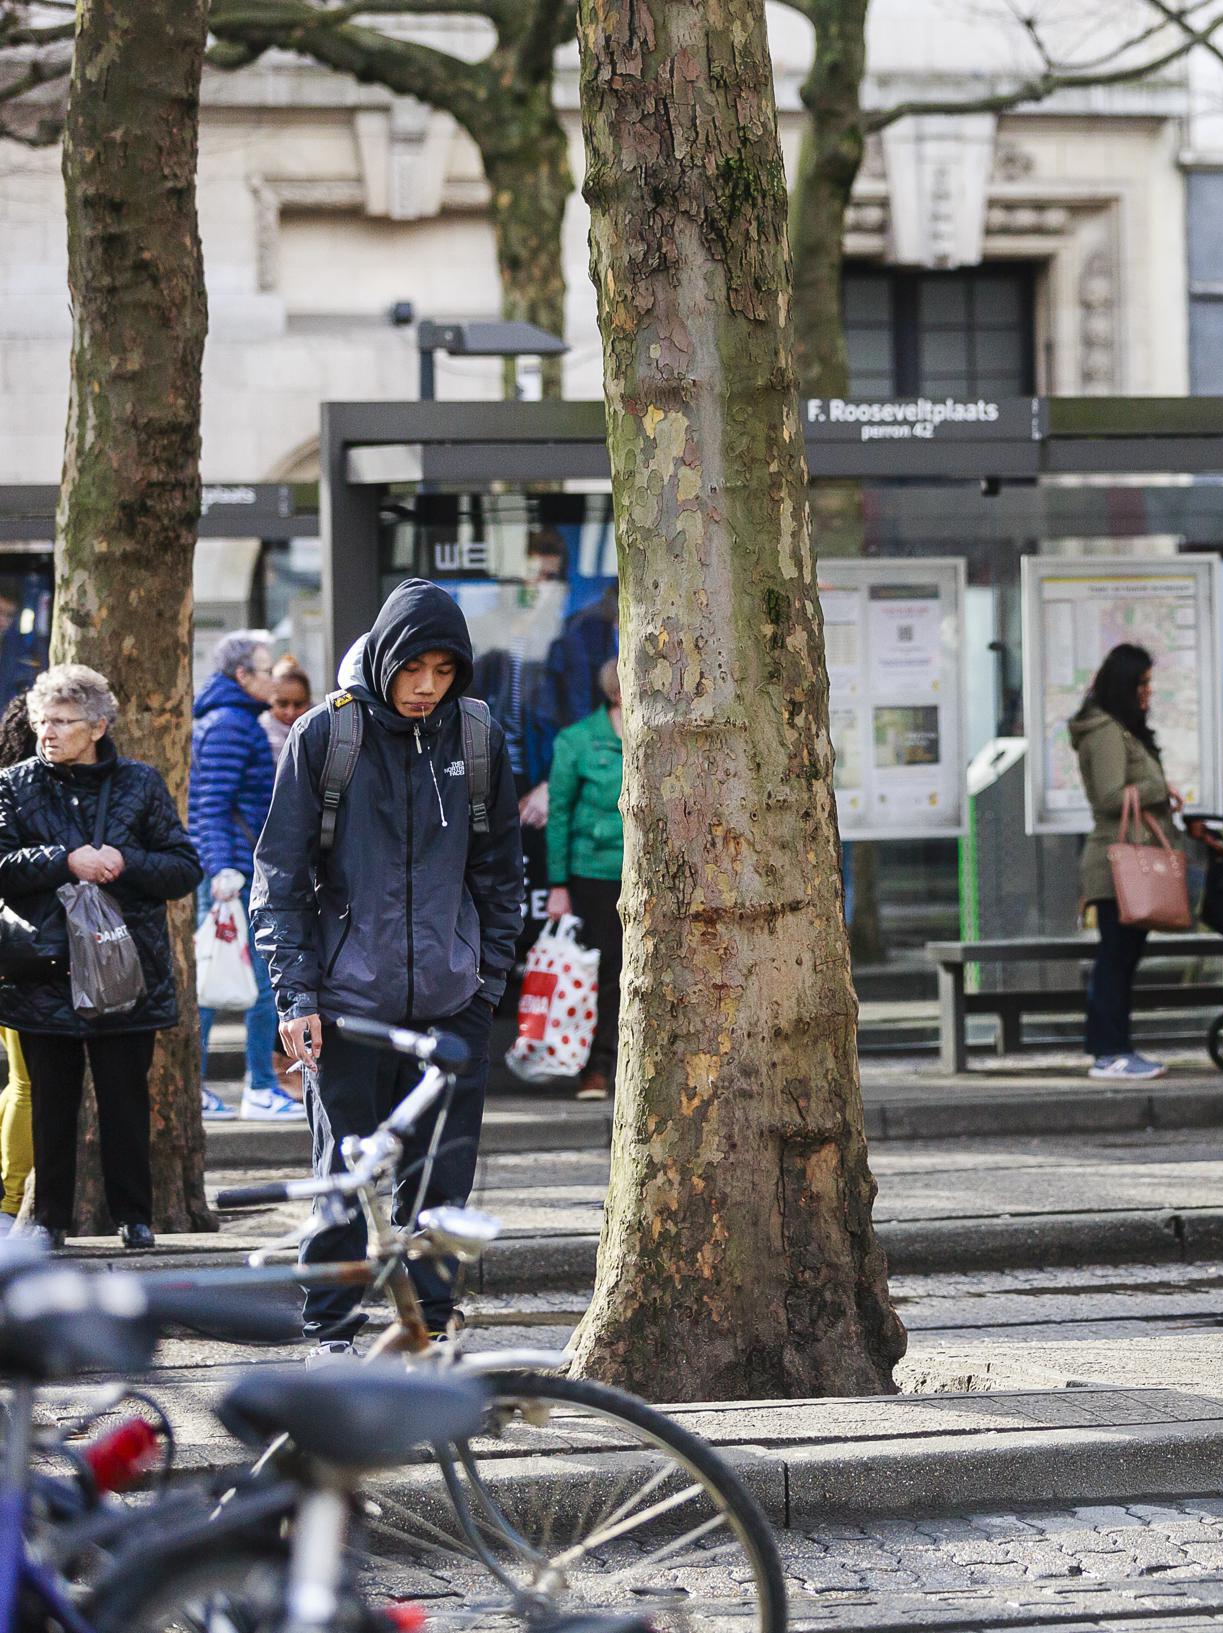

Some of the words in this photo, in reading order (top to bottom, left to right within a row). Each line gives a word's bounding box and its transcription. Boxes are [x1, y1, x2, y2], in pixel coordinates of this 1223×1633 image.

[808, 399, 826, 422] F.
[829, 398, 999, 426] Rooseveltplaats
[861, 424, 912, 442] perron
[912, 421, 935, 439] 42
